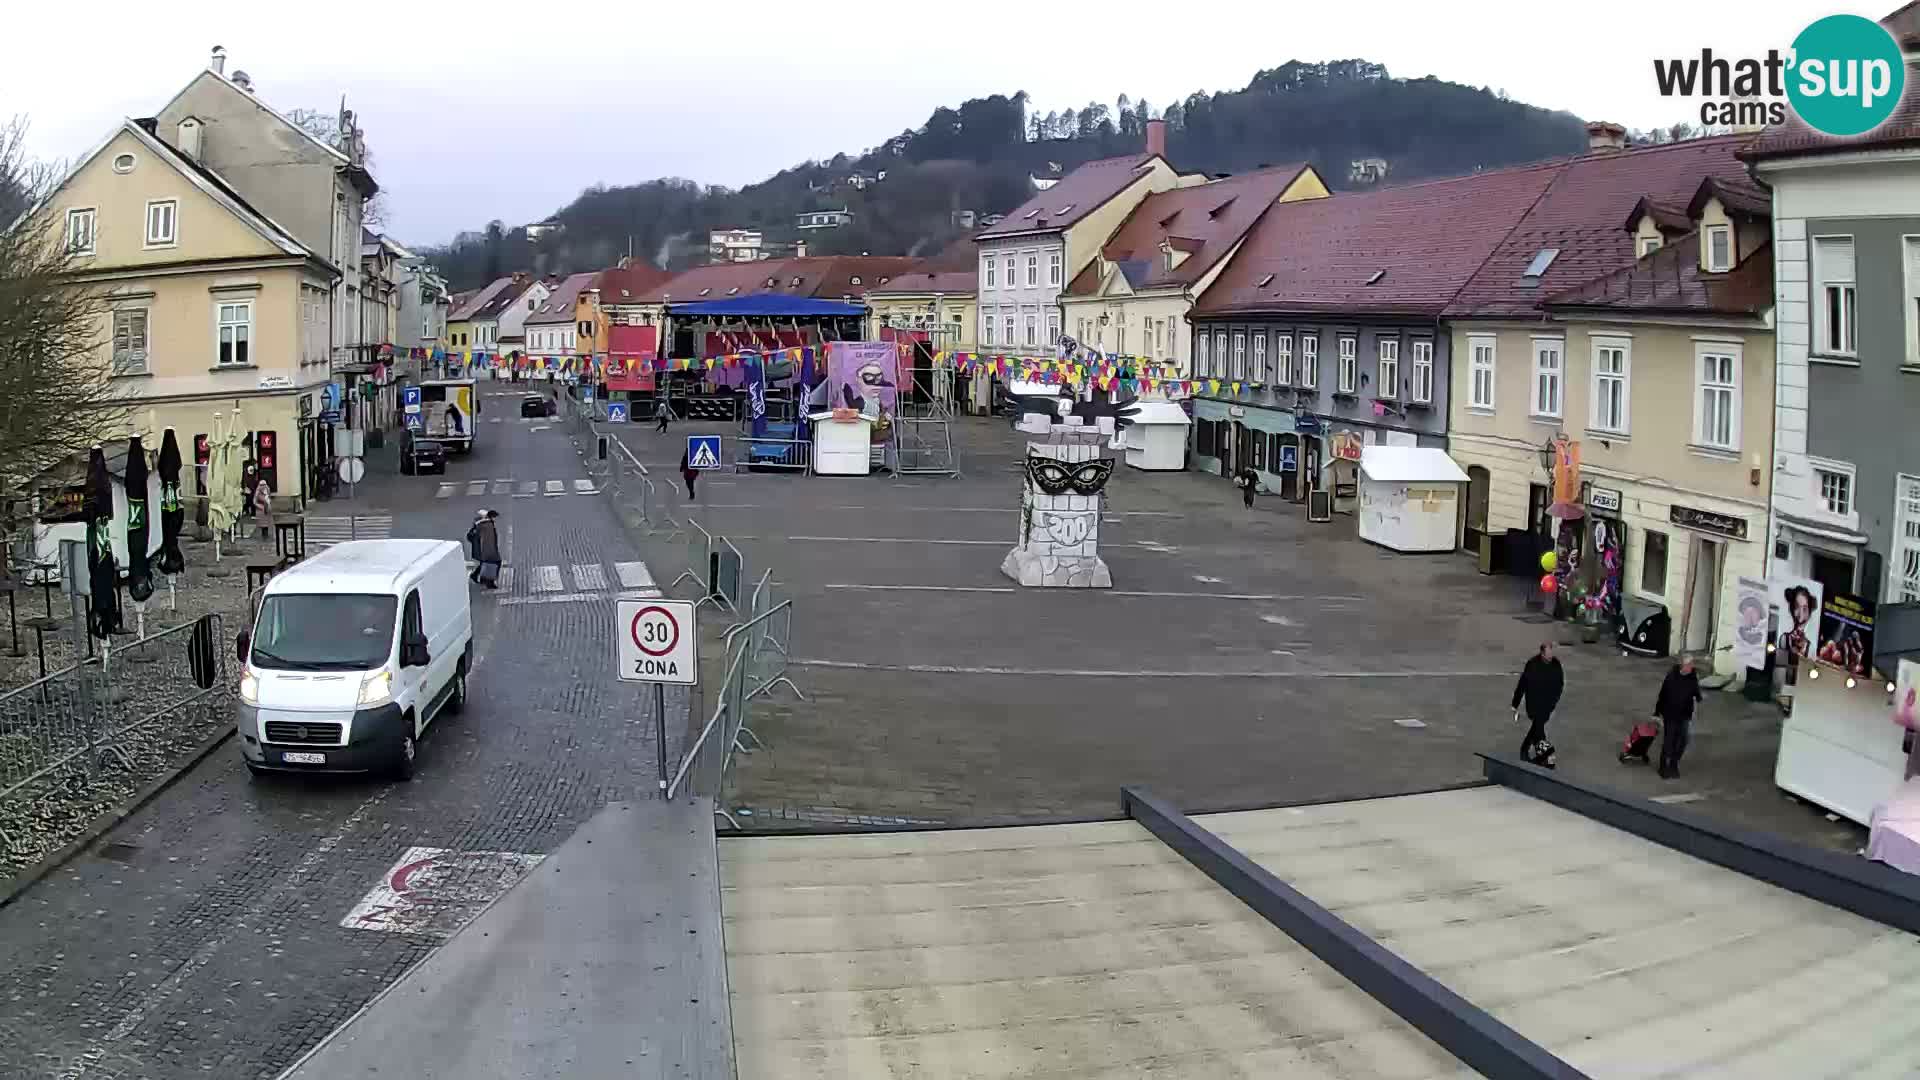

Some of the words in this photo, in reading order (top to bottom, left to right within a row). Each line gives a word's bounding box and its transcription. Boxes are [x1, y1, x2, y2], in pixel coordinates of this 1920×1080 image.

[408, 391, 416, 403] P
[1048, 516, 1087, 544] 200
[644, 622, 668, 643] 30
[634, 659, 678, 676] ZONA
